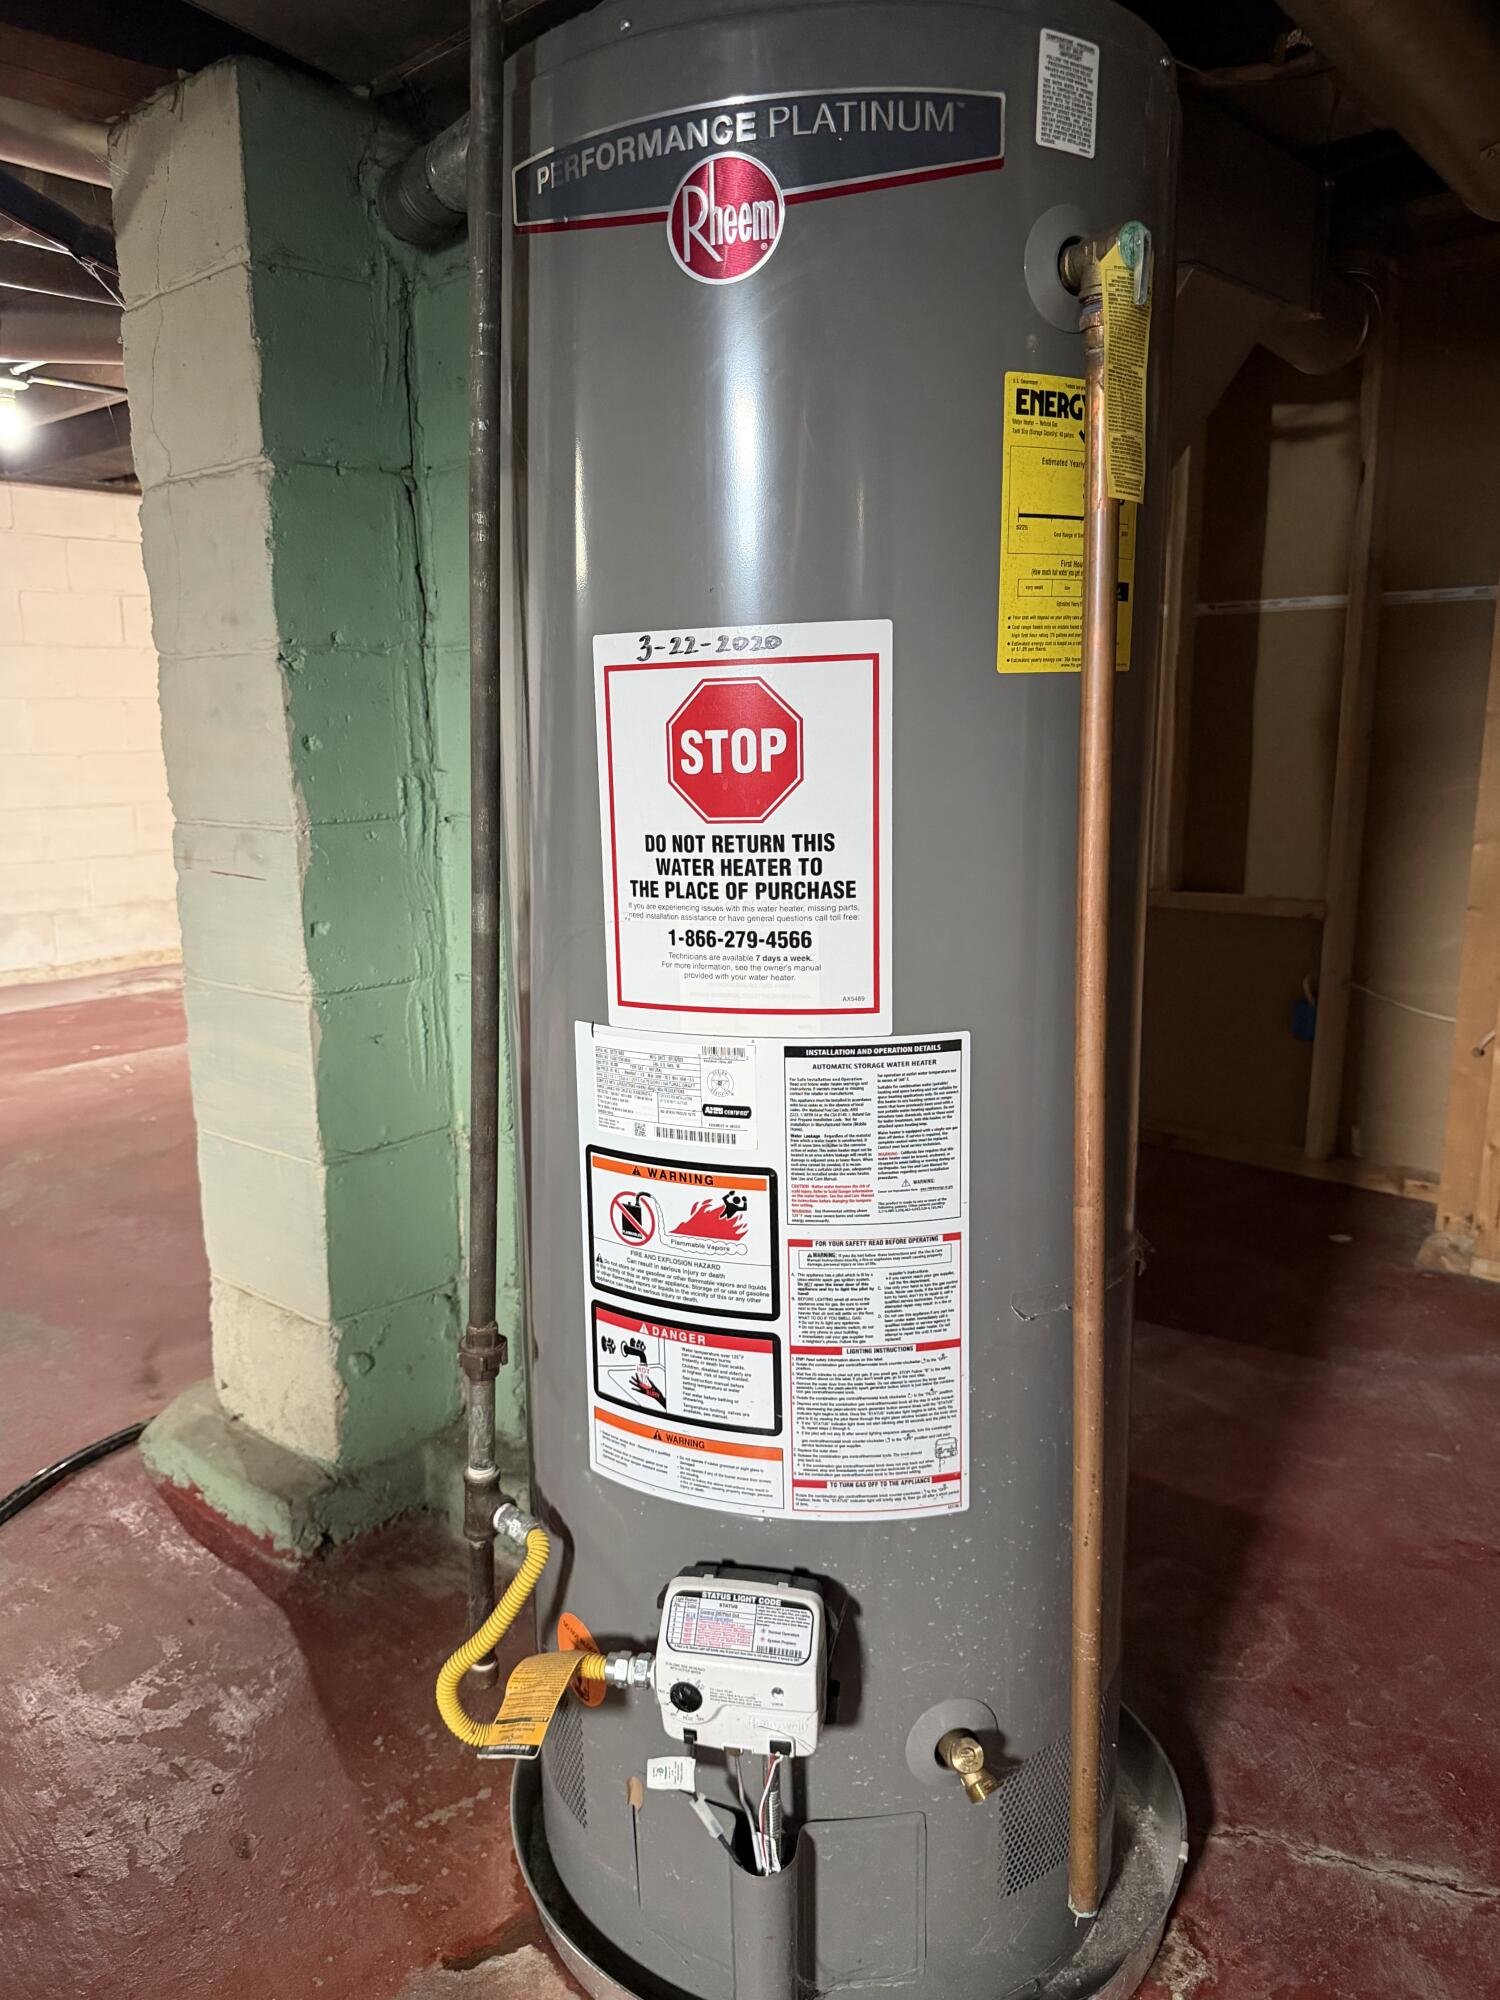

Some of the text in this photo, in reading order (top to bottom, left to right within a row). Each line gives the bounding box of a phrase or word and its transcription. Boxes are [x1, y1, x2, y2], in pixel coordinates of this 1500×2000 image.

[536, 112, 756, 195] PERFORMANCE
[682, 160, 776, 263] Rheem
[1042, 458, 1067, 466] Estimated
[1060, 560, 1084, 569] First Hou
[636, 634, 782, 662] 3-22-2020
[680, 728, 787, 774] STOP
[644, 832, 835, 853] DO NOT RETURN THIS
[655, 857, 822, 876] WATER HEATER TO
[630, 880, 856, 900] THE PLACE OF PURCHASE
[657, 904, 699, 912] experiencing
[807, 905, 836, 913] missing
[838, 904, 859, 912] parts,
[629, 912, 643, 920] need
[746, 914, 774, 923] general
[776, 915, 812, 923] questions
[668, 929, 812, 948] 1-866-279-4566
[669, 952, 707, 960] Technicians
[762, 955, 781, 963] days
[661, 960, 672, 968] For
[692, 962, 733, 971] information,
[734, 962, 748, 971] see
[763, 962, 792, 971] owner's
[806, 1048, 856, 1056] INSTALLATION
[874, 1046, 913, 1054] OPERATION
[914, 1044, 942, 1052] DETAILS
[648, 1168, 714, 1186] WARNING
[670, 1238, 730, 1252] Flammable Vapors
[868, 1238, 884, 1246] READ
[908, 1236, 938, 1244] OPERATING
[626, 1256, 636, 1264] Can
[638, 1259, 652, 1268] result
[660, 1264, 681, 1273] serious
[682, 1268, 699, 1277] injury
[630, 1249, 720, 1270] FIRE AND EXPLOSION HAZARD
[652, 1328, 706, 1344] DANGER
[636, 1366, 650, 1374] HOT
[666, 1434, 704, 1449] WARNING
[702, 1592, 782, 1606] STATUS LIGHT CODE
